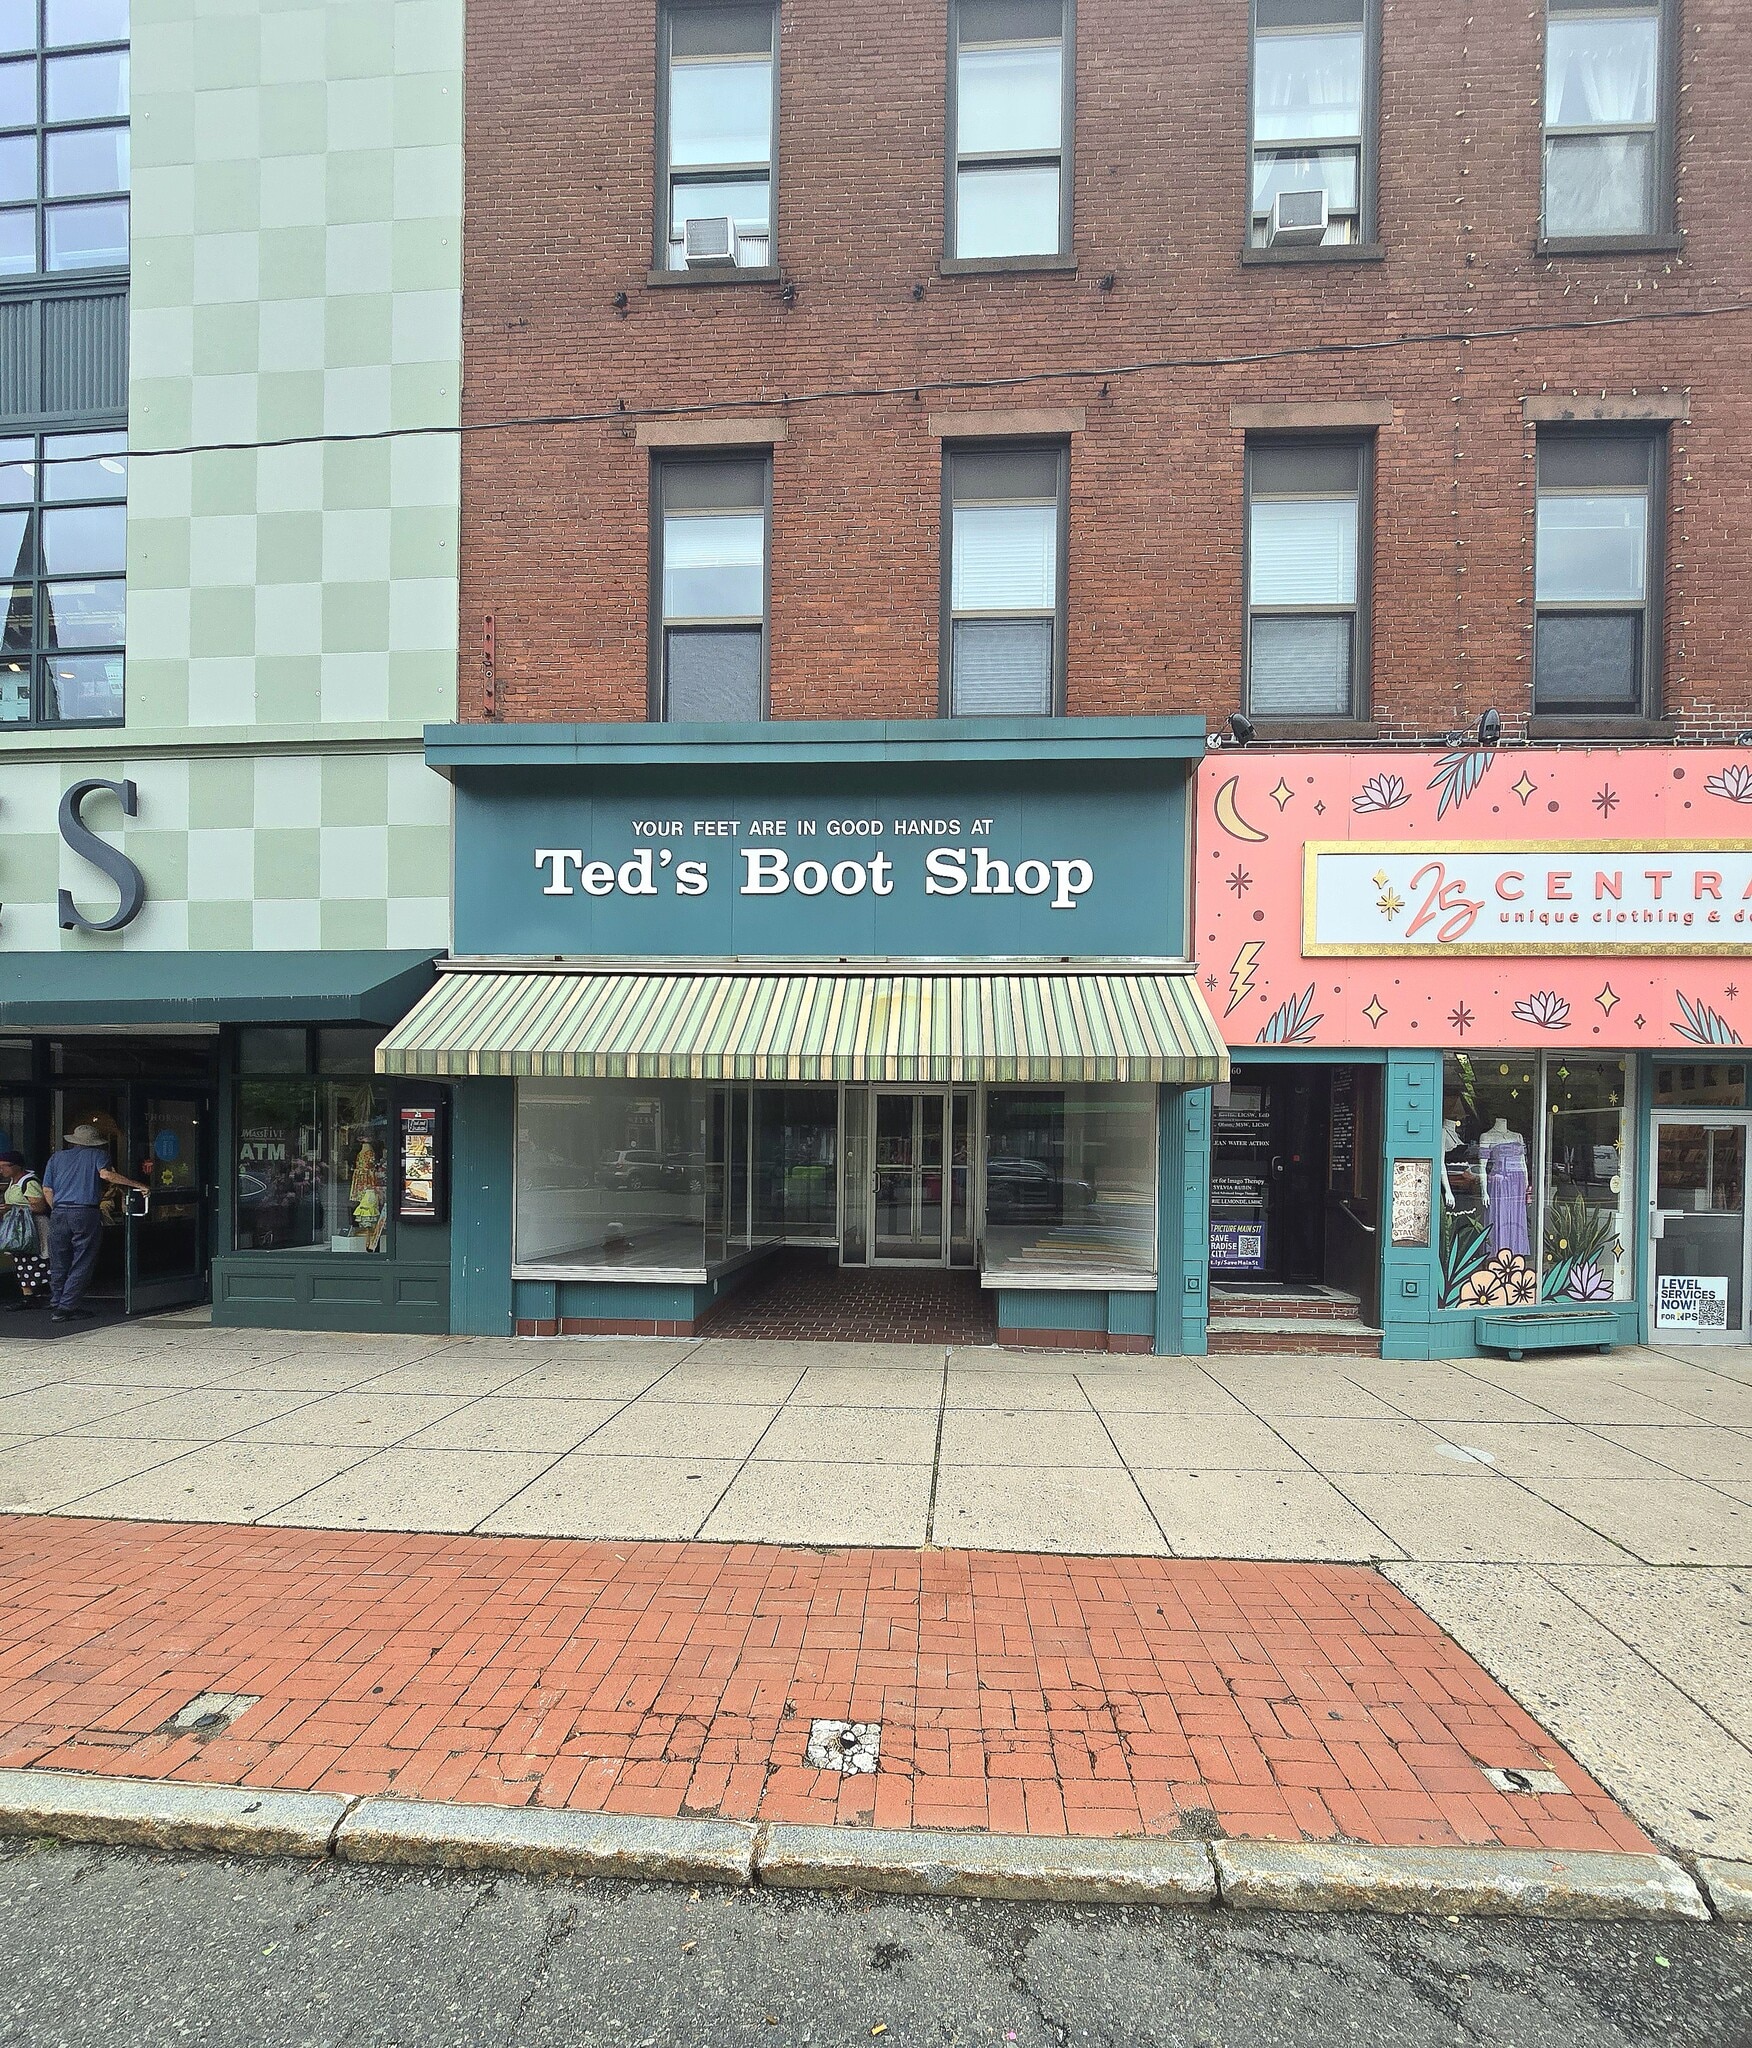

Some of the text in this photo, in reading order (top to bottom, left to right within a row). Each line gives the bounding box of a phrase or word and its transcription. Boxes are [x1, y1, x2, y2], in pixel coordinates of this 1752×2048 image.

[632, 819, 993, 836] YOUR FEET ARE IN GOOD HANDS AT
[58, 778, 145, 931] S
[534, 848, 1094, 909] Ted's Boot Shop
[1500, 909, 1580, 925] unique
[1592, 908, 1694, 926] clothing
[1708, 911, 1720, 922] &
[1232, 1067, 1242, 1075] 60
[240, 1143, 285, 1160] ATM
[1662, 1279, 1701, 1289] LEVEL
[1661, 1290, 1716, 1299] SERVICES
[1661, 1300, 1696, 1310] NOW!
